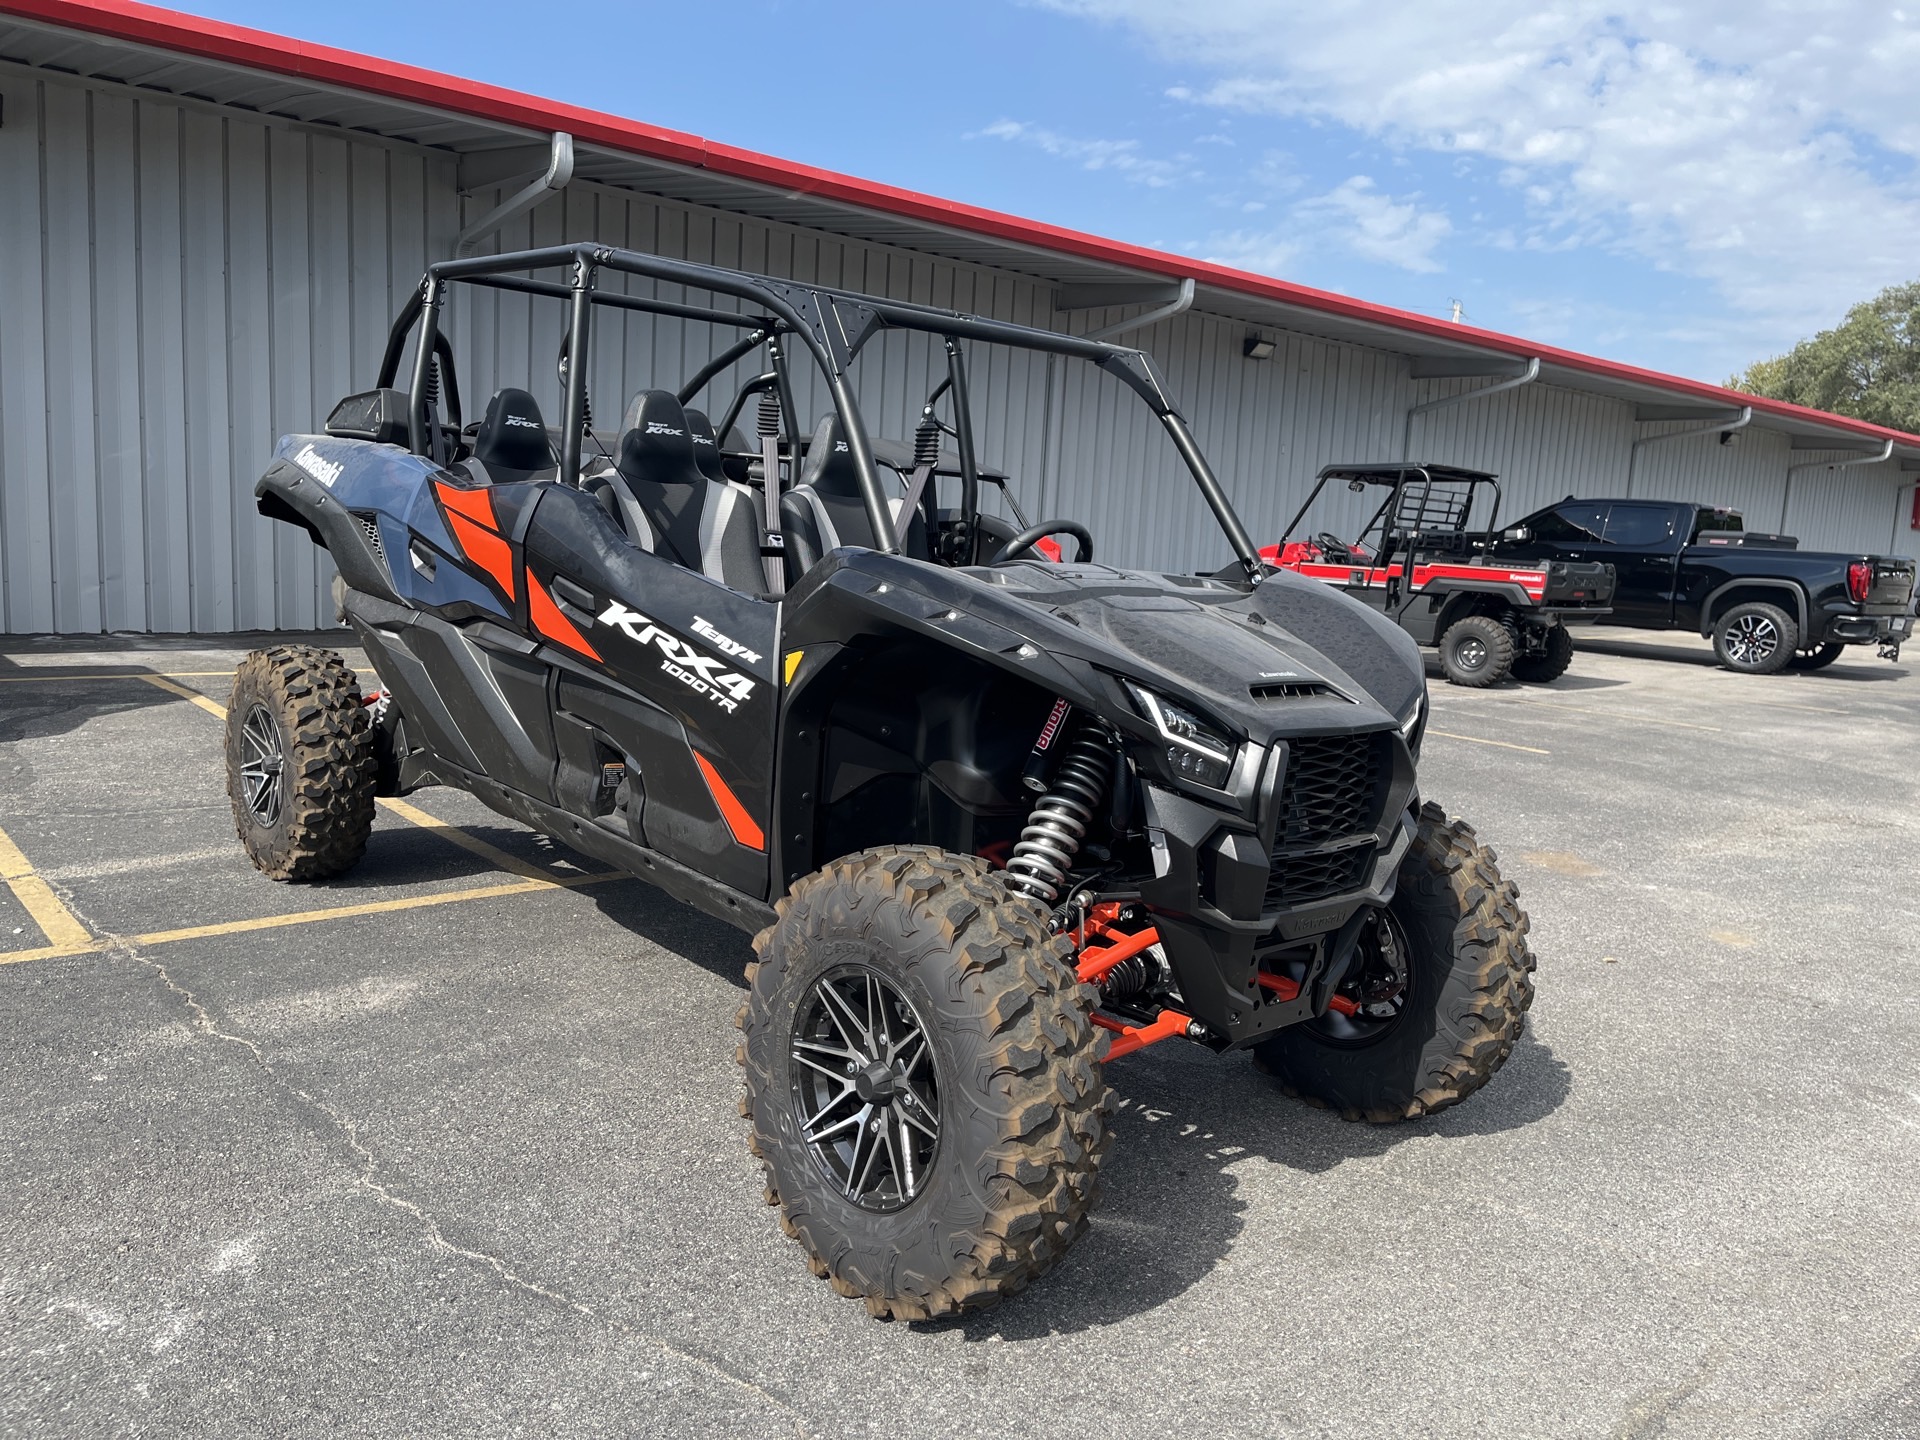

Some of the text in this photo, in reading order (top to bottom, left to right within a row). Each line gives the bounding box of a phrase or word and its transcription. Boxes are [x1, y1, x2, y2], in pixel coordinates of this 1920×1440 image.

[504, 419, 540, 429] KRX
[645, 426, 684, 436] KRX
[293, 443, 345, 488] Kawasaki
[1509, 573, 1542, 582] Kawasaki
[597, 598, 756, 702] KRX4
